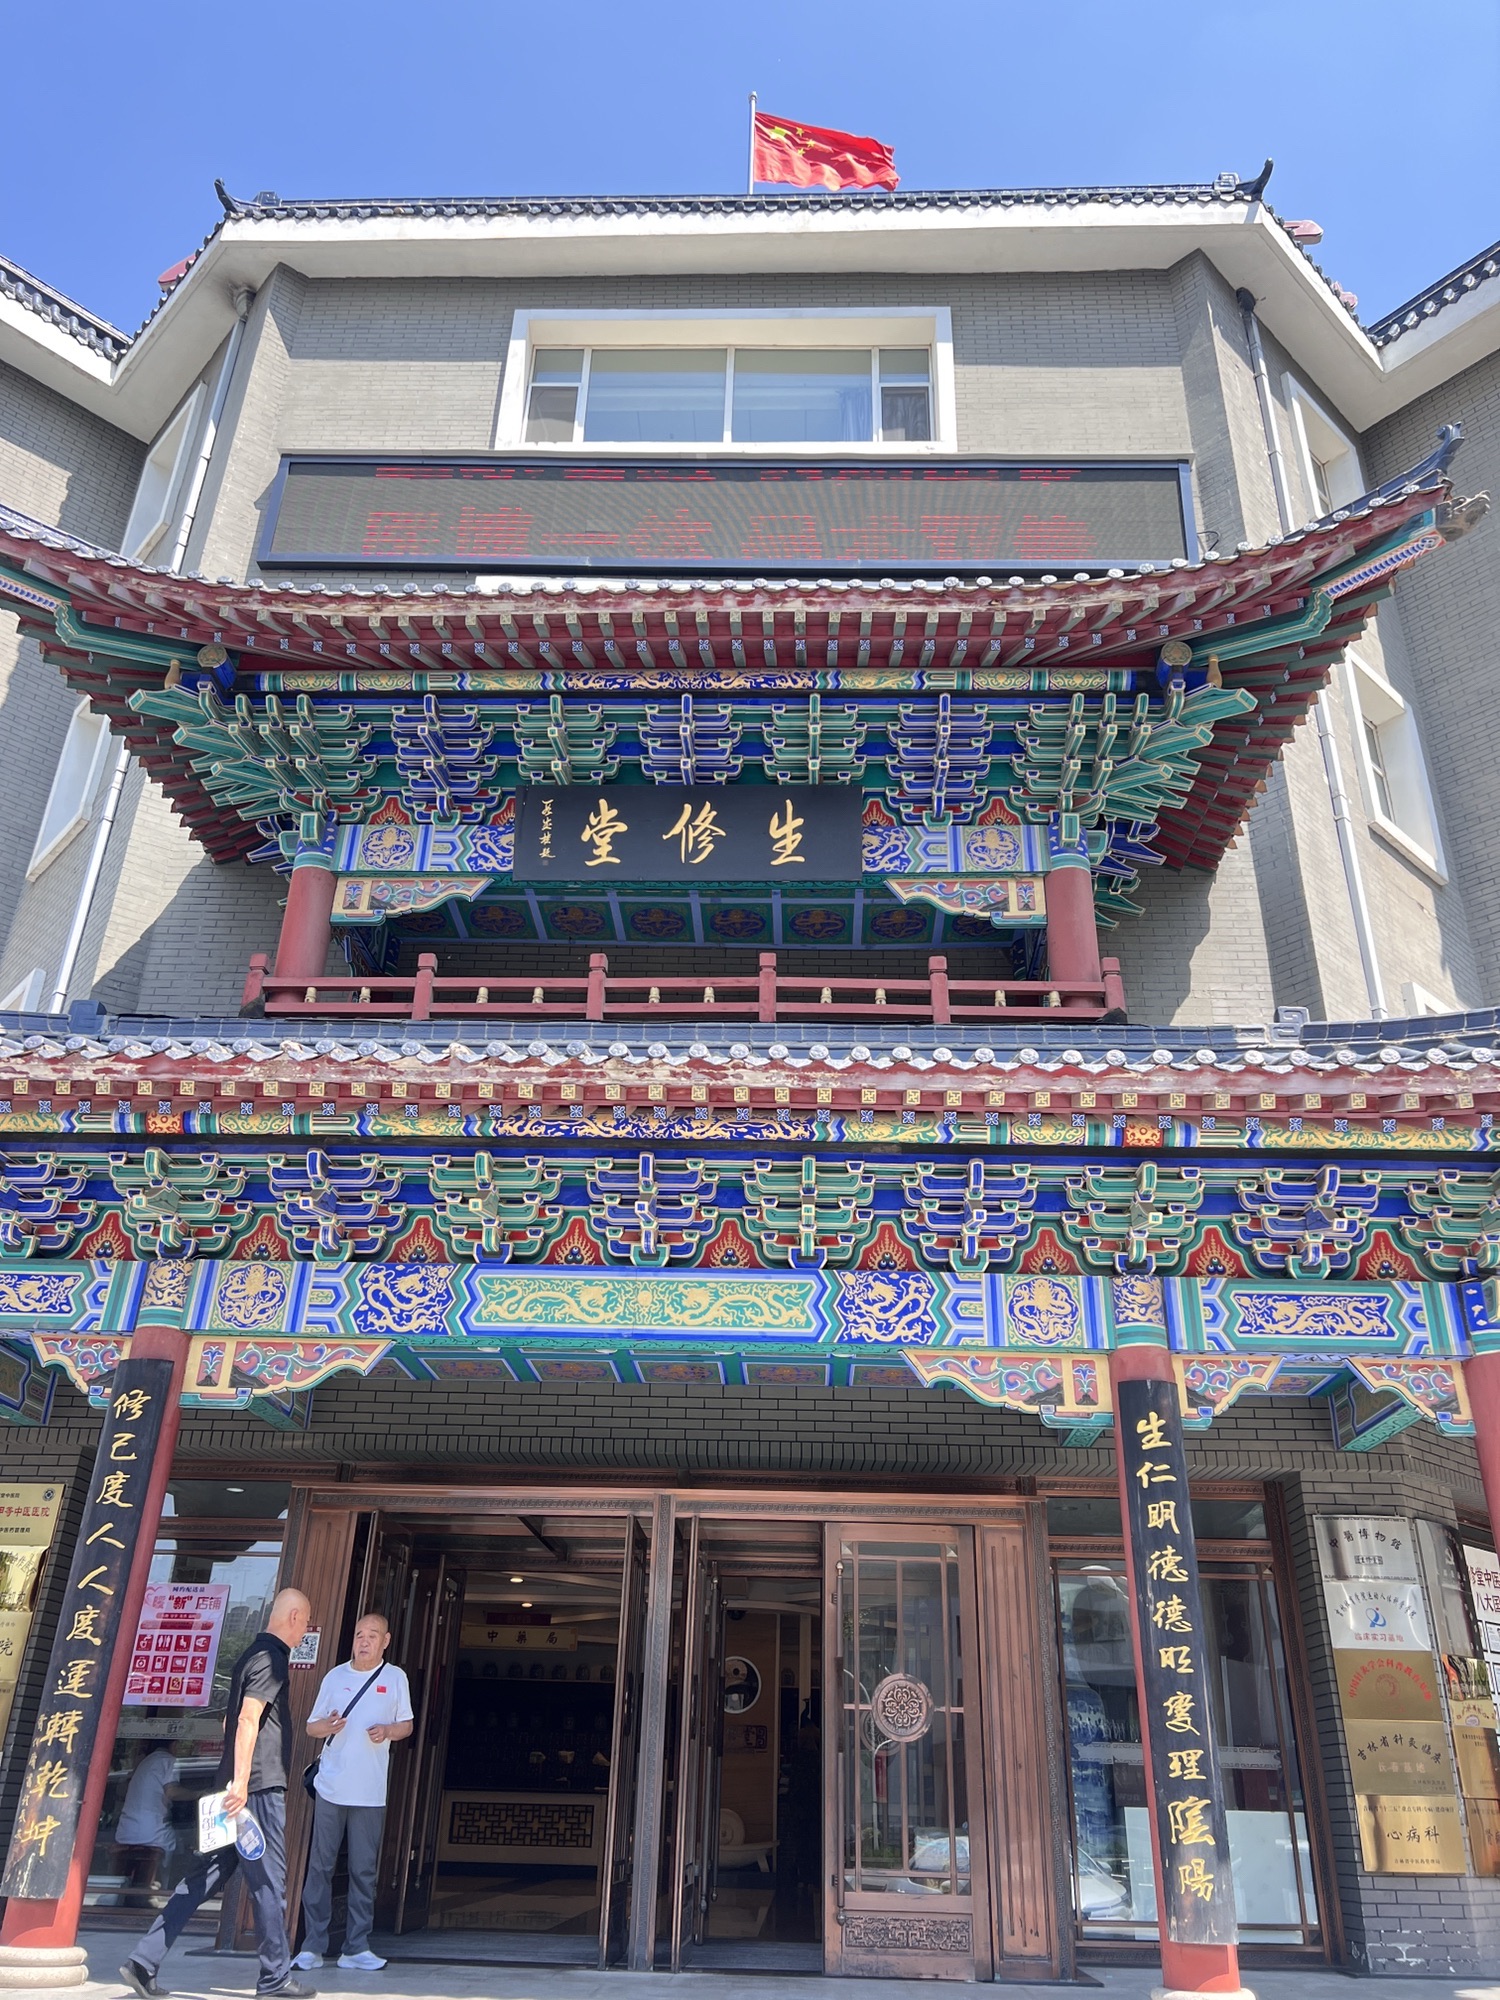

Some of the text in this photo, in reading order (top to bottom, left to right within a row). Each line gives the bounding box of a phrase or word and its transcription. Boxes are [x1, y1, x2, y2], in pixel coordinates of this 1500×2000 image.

[581, 798, 806, 867] 生修堂
[1387, 1825, 1440, 1844] 心病科
